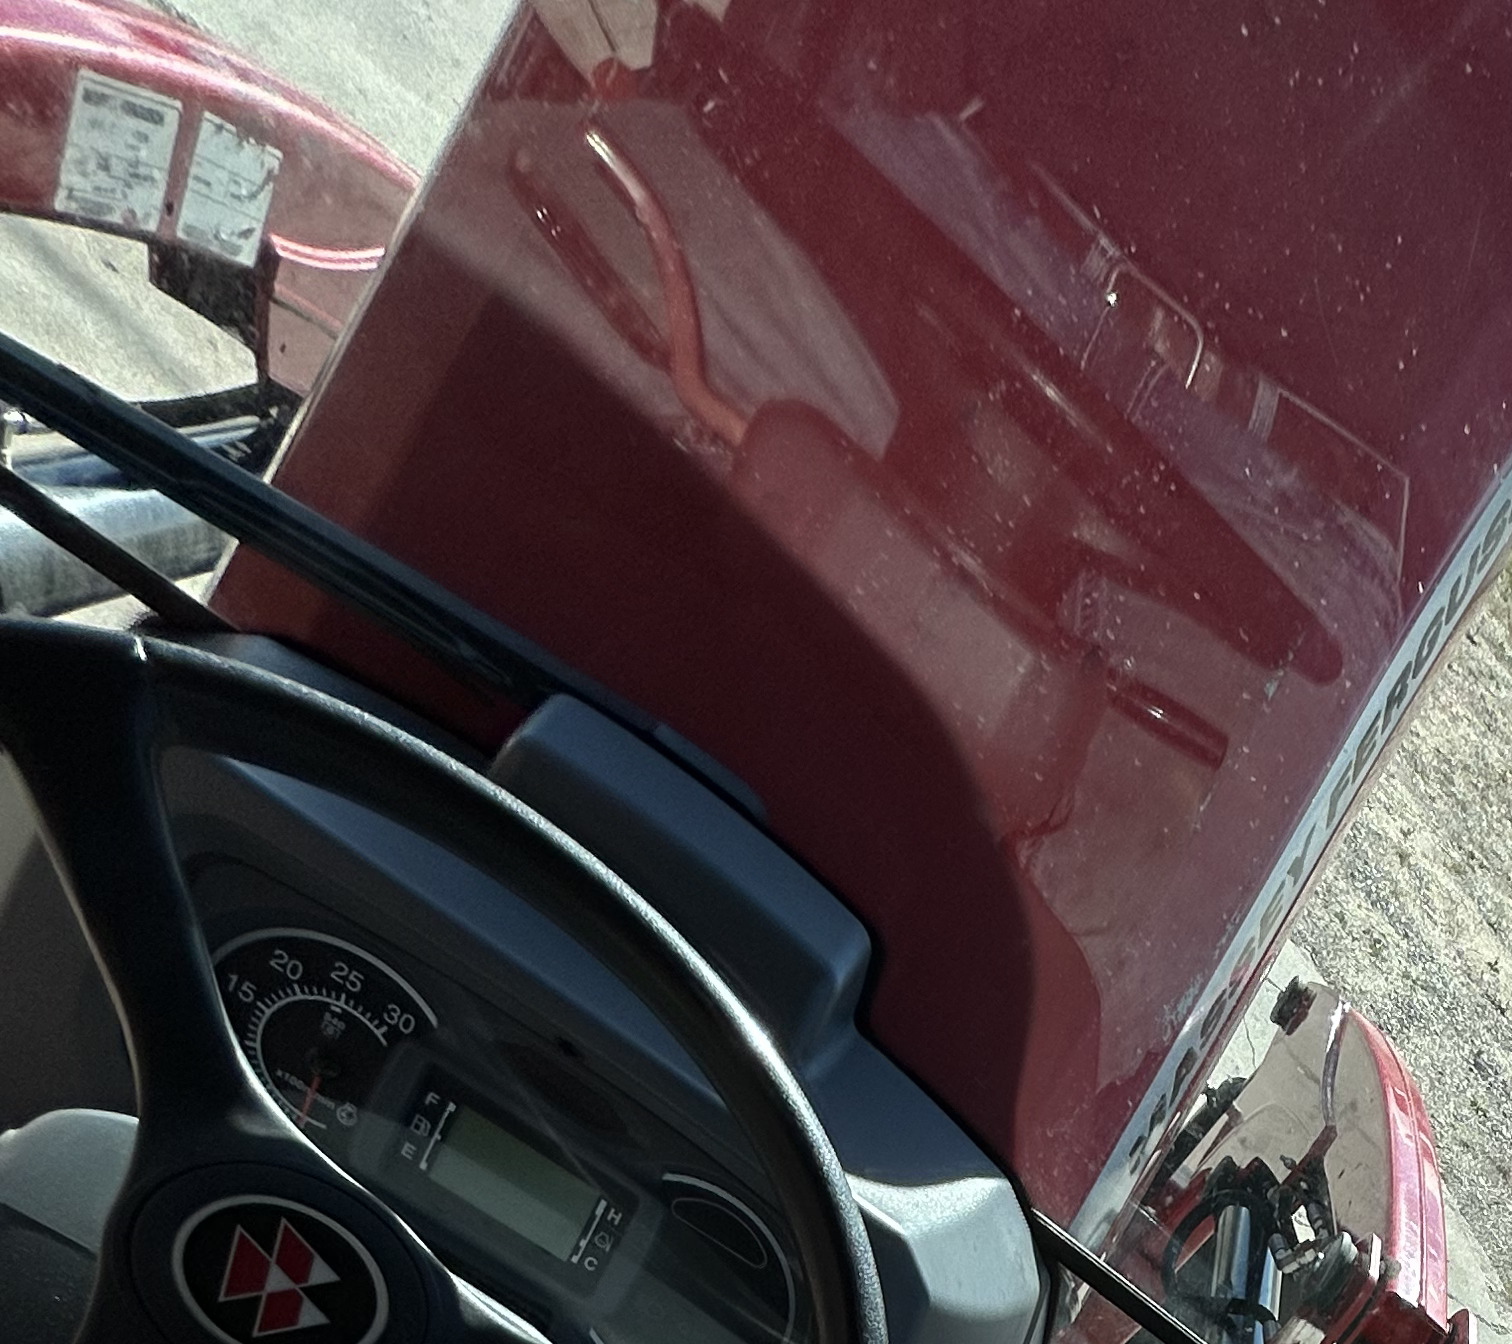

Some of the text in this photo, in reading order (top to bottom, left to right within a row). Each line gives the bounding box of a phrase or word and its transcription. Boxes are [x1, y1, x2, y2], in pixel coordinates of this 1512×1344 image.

[269, 950, 303, 980] 20
[330, 962, 365, 992] 25
[227, 973, 257, 1003] 15
[383, 1004, 415, 1034] 30
[425, 1092, 441, 1106] F
[401, 1142, 416, 1160] E
[607, 1208, 622, 1225] H
[584, 1257, 598, 1271] C
